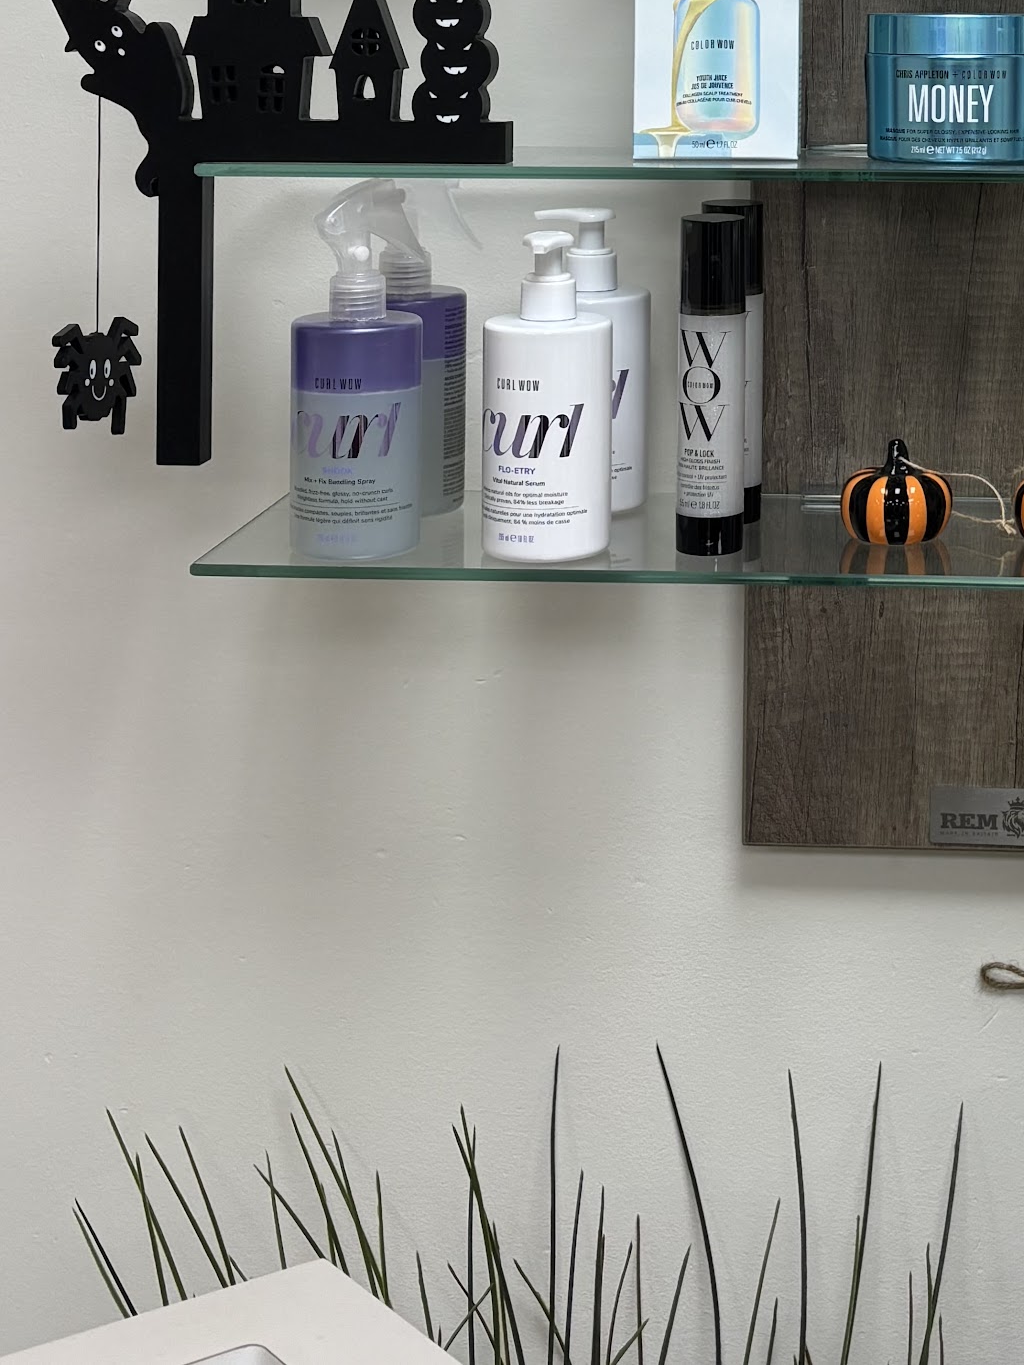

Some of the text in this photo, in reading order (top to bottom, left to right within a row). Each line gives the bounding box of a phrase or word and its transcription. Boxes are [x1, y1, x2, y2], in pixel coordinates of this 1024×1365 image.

[690, 40, 734, 50] COLOR WOW
[908, 84, 994, 123] MONEY
[315, 378, 362, 390] CURL WOW
[497, 377, 540, 392] CURL WOW
[679, 328, 732, 442] WOW
[483, 403, 585, 459] curl
[700, 450, 714, 458] LOCK
[498, 466, 536, 475] FLO-ETRY
[504, 478, 524, 486] Natural
[940, 813, 999, 830] REM
